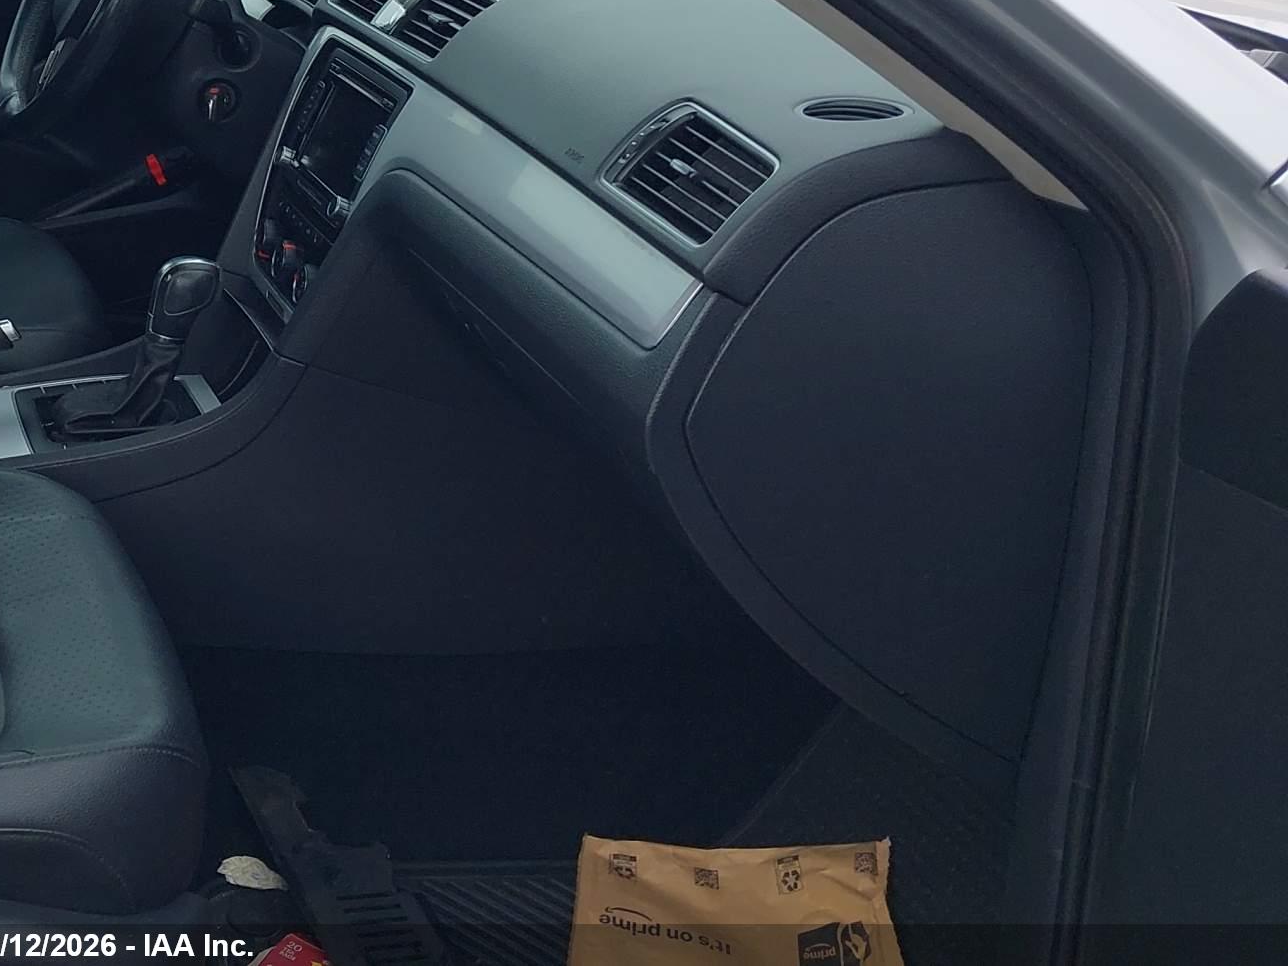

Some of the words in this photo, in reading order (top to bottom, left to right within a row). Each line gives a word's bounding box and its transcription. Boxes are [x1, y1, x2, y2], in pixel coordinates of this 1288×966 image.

[599, 914, 661, 939] prime
[666, 927, 694, 943] on
[286, 940, 303, 952] 20
[700, 935, 732, 955] It's
[802, 945, 837, 961] prime
